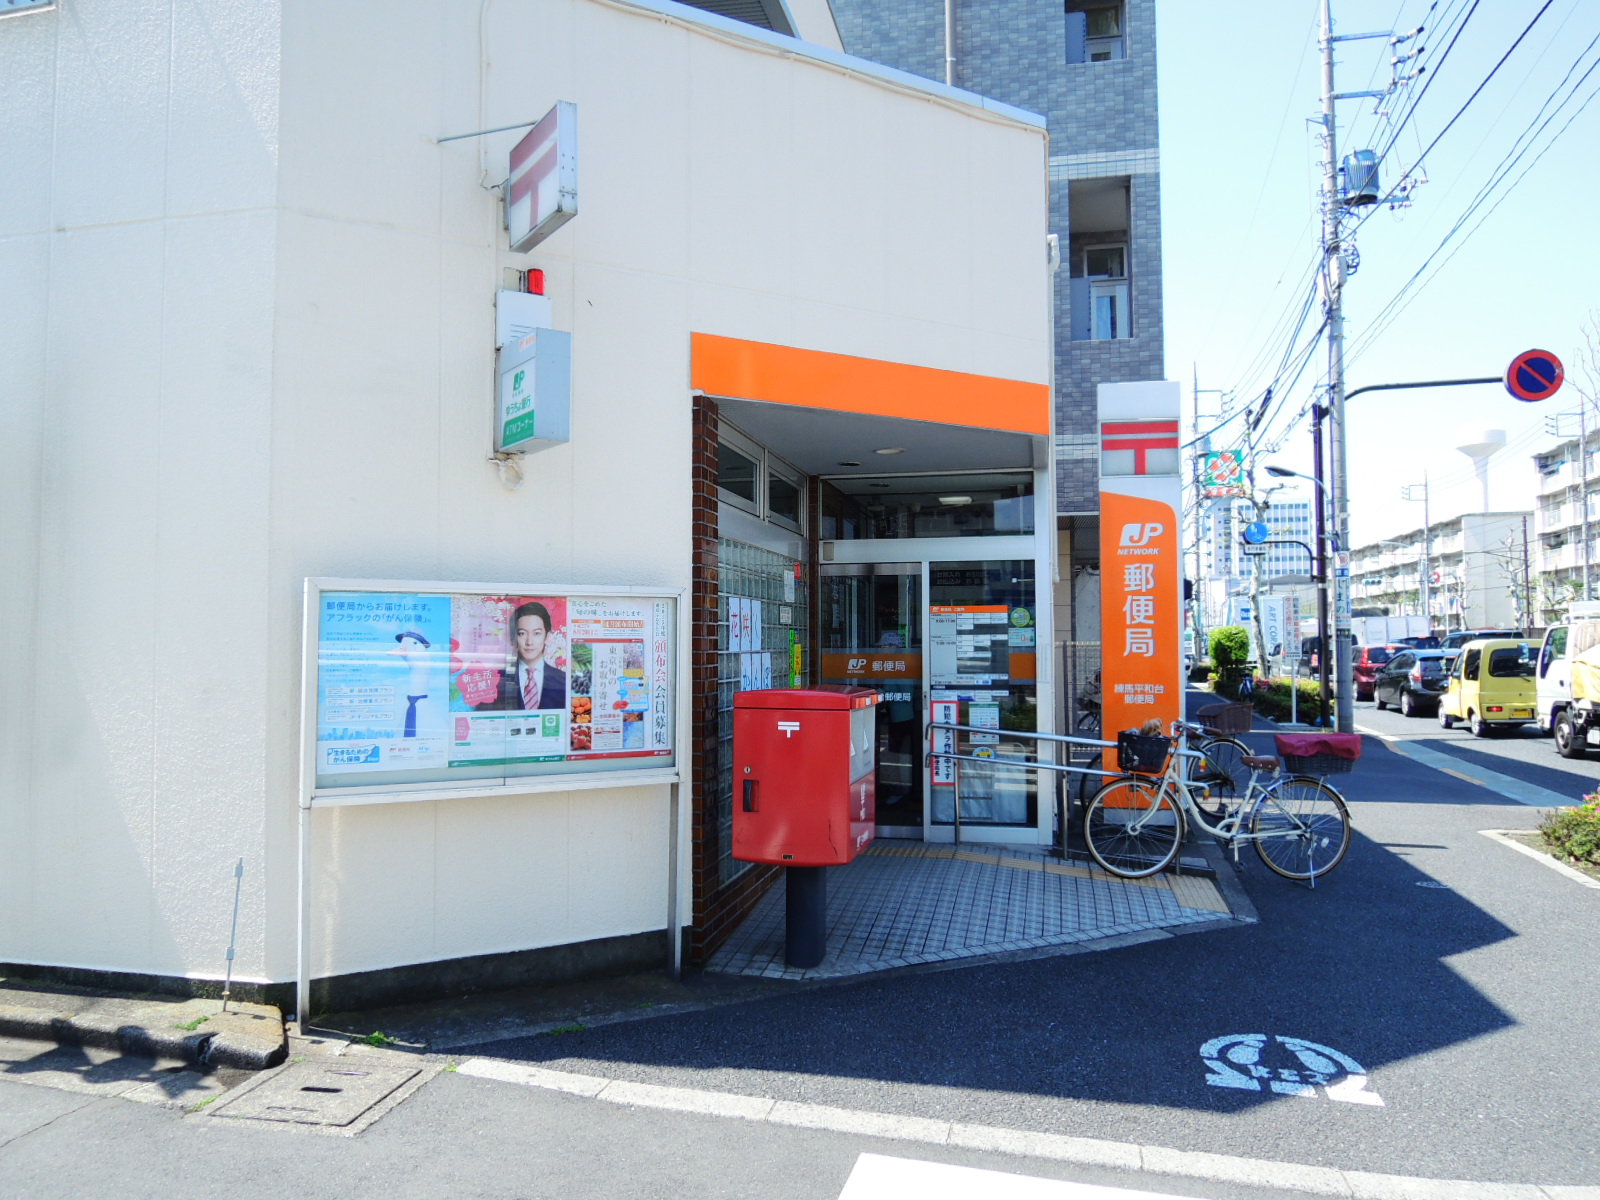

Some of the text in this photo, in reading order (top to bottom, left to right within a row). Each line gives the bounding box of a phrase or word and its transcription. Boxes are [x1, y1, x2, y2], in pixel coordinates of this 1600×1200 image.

[506, 396, 531, 416] ゆうちょ銀行
[506, 418, 532, 436] ATMコーナー
[1120, 522, 1164, 546] JP
[326, 602, 431, 612] 郵便局からお届けします。
[1124, 563, 1156, 656] 郵便局
[327, 614, 431, 623] アフラックの「がん保険」。
[848, 659, 906, 672] JP 郵便局
[463, 670, 492, 682] 新生活
[1114, 684, 1164, 694] 練馬平和台
[1125, 695, 1155, 704] 郵便局
